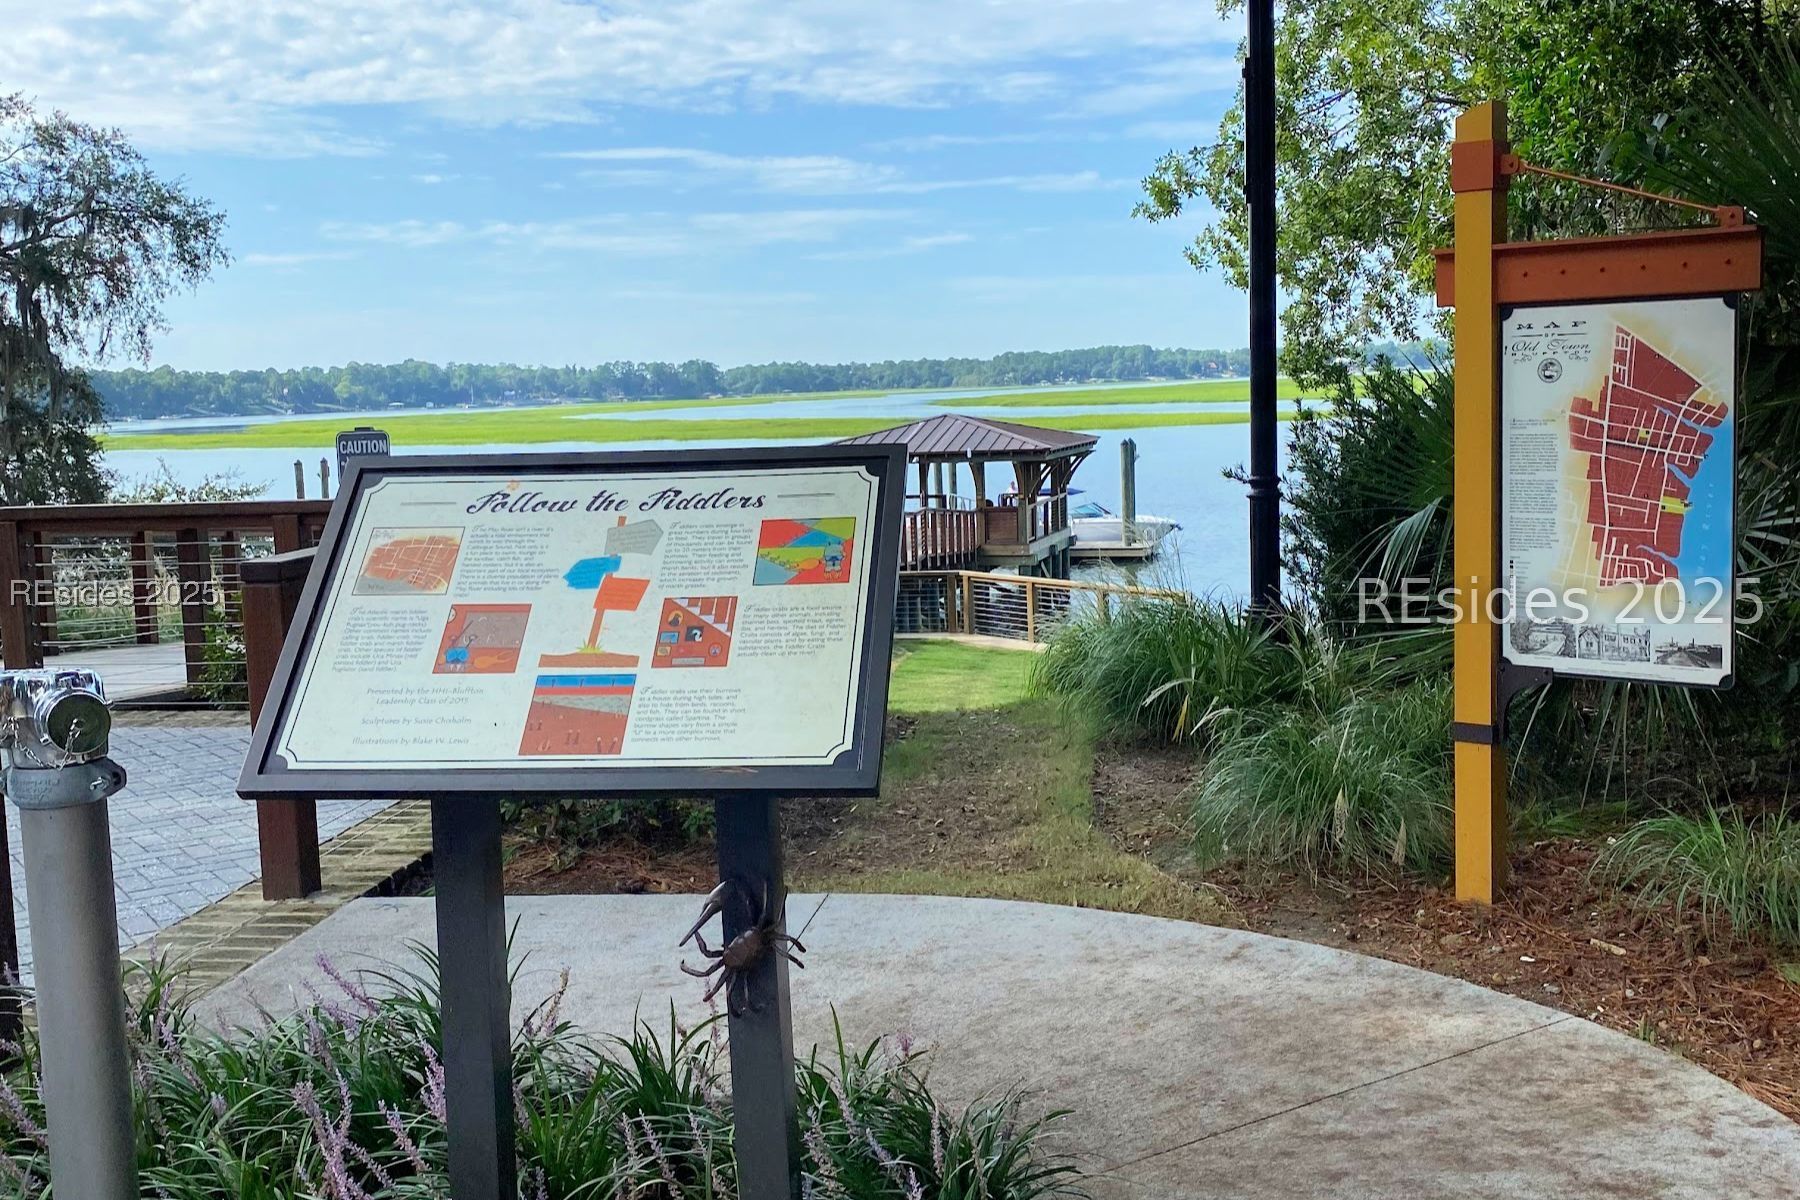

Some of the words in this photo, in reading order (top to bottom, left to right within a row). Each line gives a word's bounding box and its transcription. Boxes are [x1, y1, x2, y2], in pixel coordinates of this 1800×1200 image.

[1517, 321, 1586, 330] MAP
[1512, 340, 1540, 351] Old
[1547, 339, 1588, 350] Town
[340, 440, 387, 453] CAUTION
[466, 489, 578, 515] Follow
[586, 489, 628, 512] the
[639, 487, 765, 512] Fiddlers
[376, 698, 416, 706] Leadership
